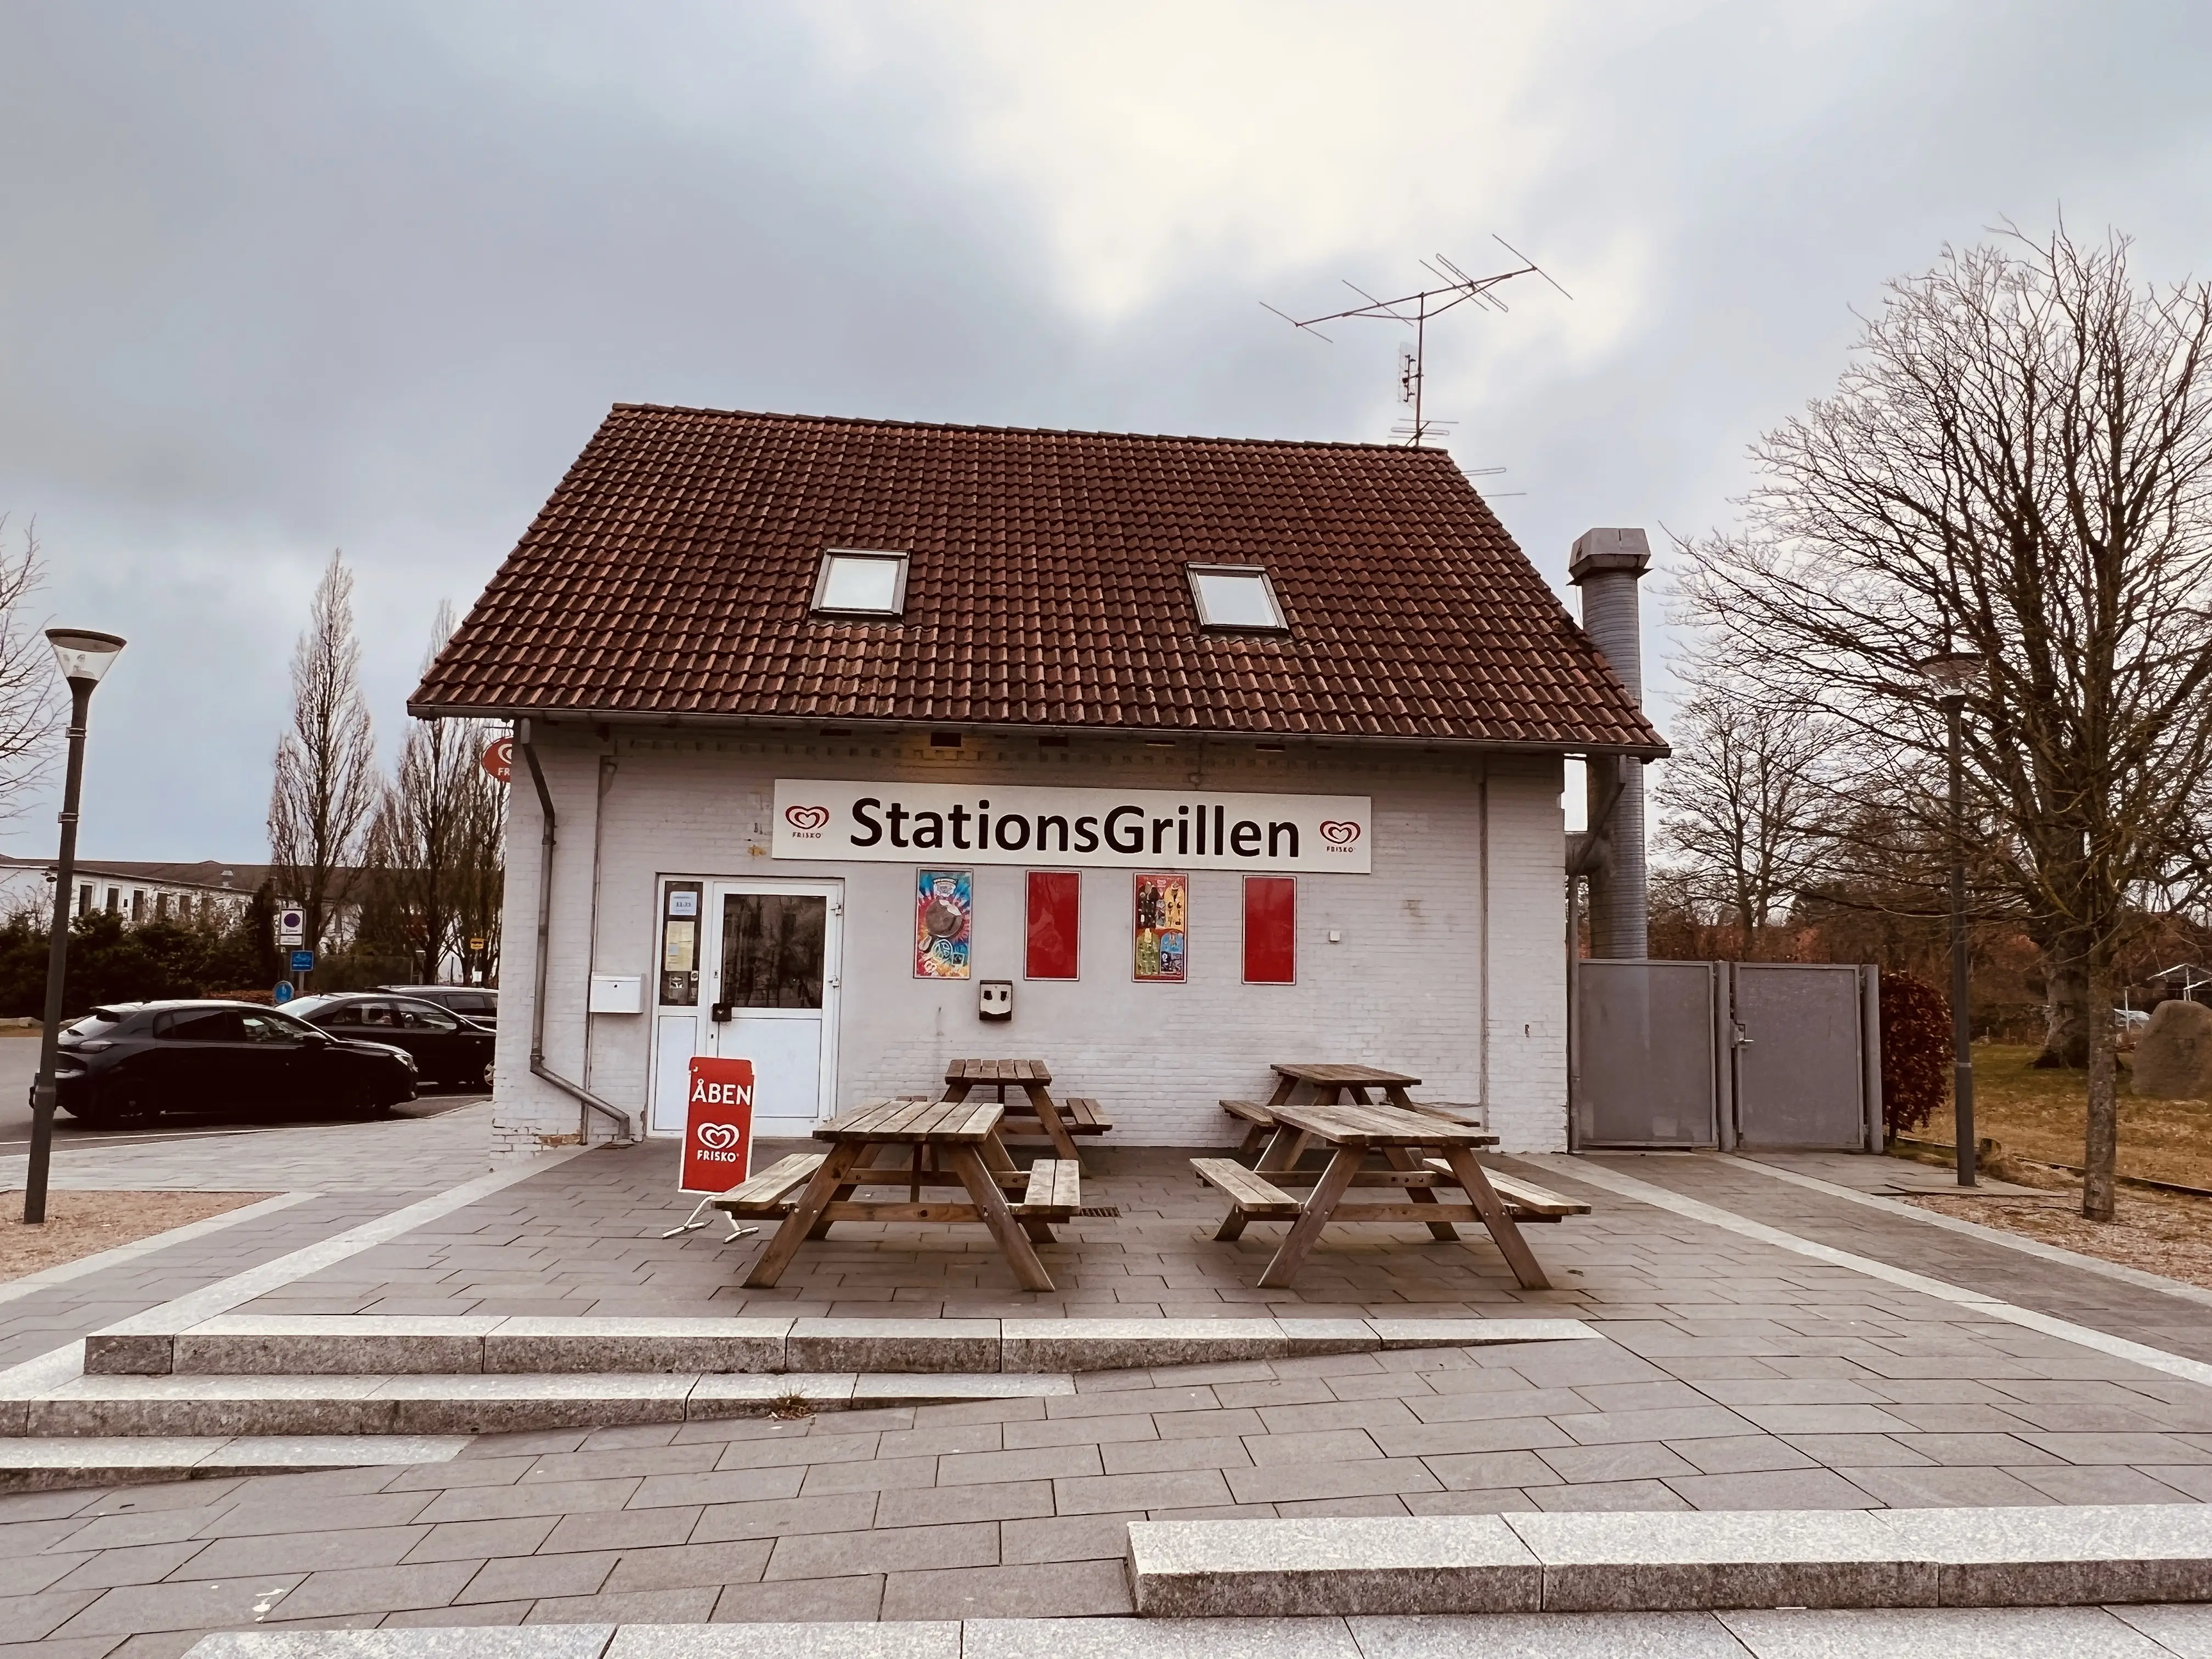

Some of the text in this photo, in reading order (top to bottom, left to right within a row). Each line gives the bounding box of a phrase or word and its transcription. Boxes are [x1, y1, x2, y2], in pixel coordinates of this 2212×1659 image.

[850, 798, 1299, 857] StationsGrillen
[691, 1078, 752, 1105] ÅBEN
[697, 1150, 737, 1163] FRISKO
